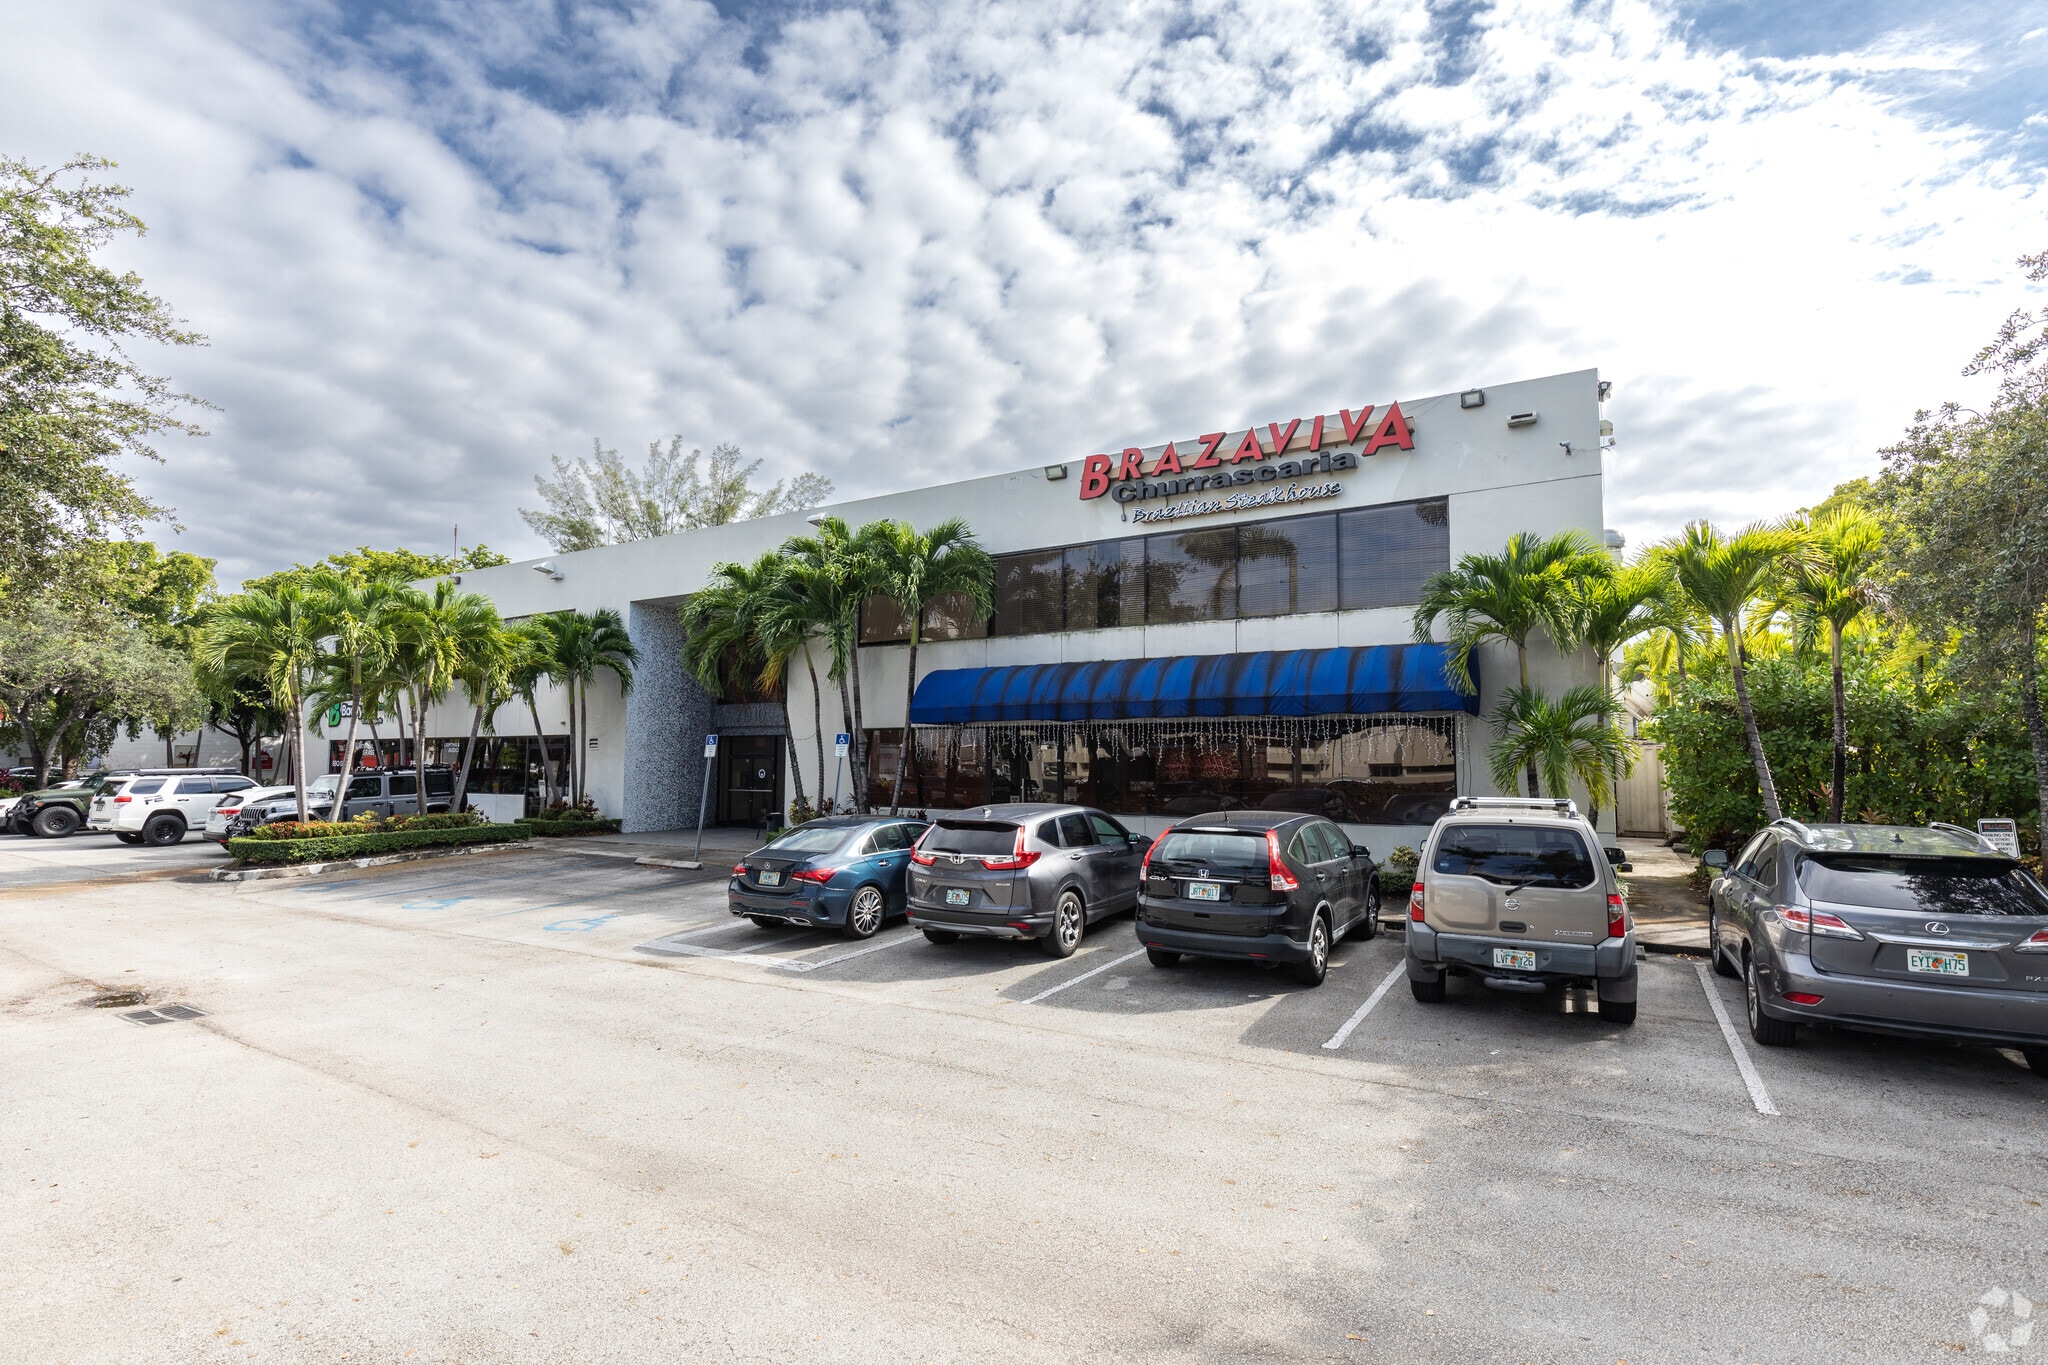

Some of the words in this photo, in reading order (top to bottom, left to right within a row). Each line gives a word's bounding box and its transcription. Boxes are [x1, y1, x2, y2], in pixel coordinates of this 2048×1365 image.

[1079, 400, 1415, 500] BRAZAVIVA
[1111, 450, 1359, 503] Churrascaria
[1132, 498, 1223, 524] Brazilian
[1223, 482, 1343, 511] Steakhouse
[1190, 887, 1202, 896] JRT
[1495, 953, 1509, 964] LVF
[1519, 955, 1534, 967] Y26
[1911, 955, 1931, 968] EYI
[1944, 957, 1966, 971] H75
